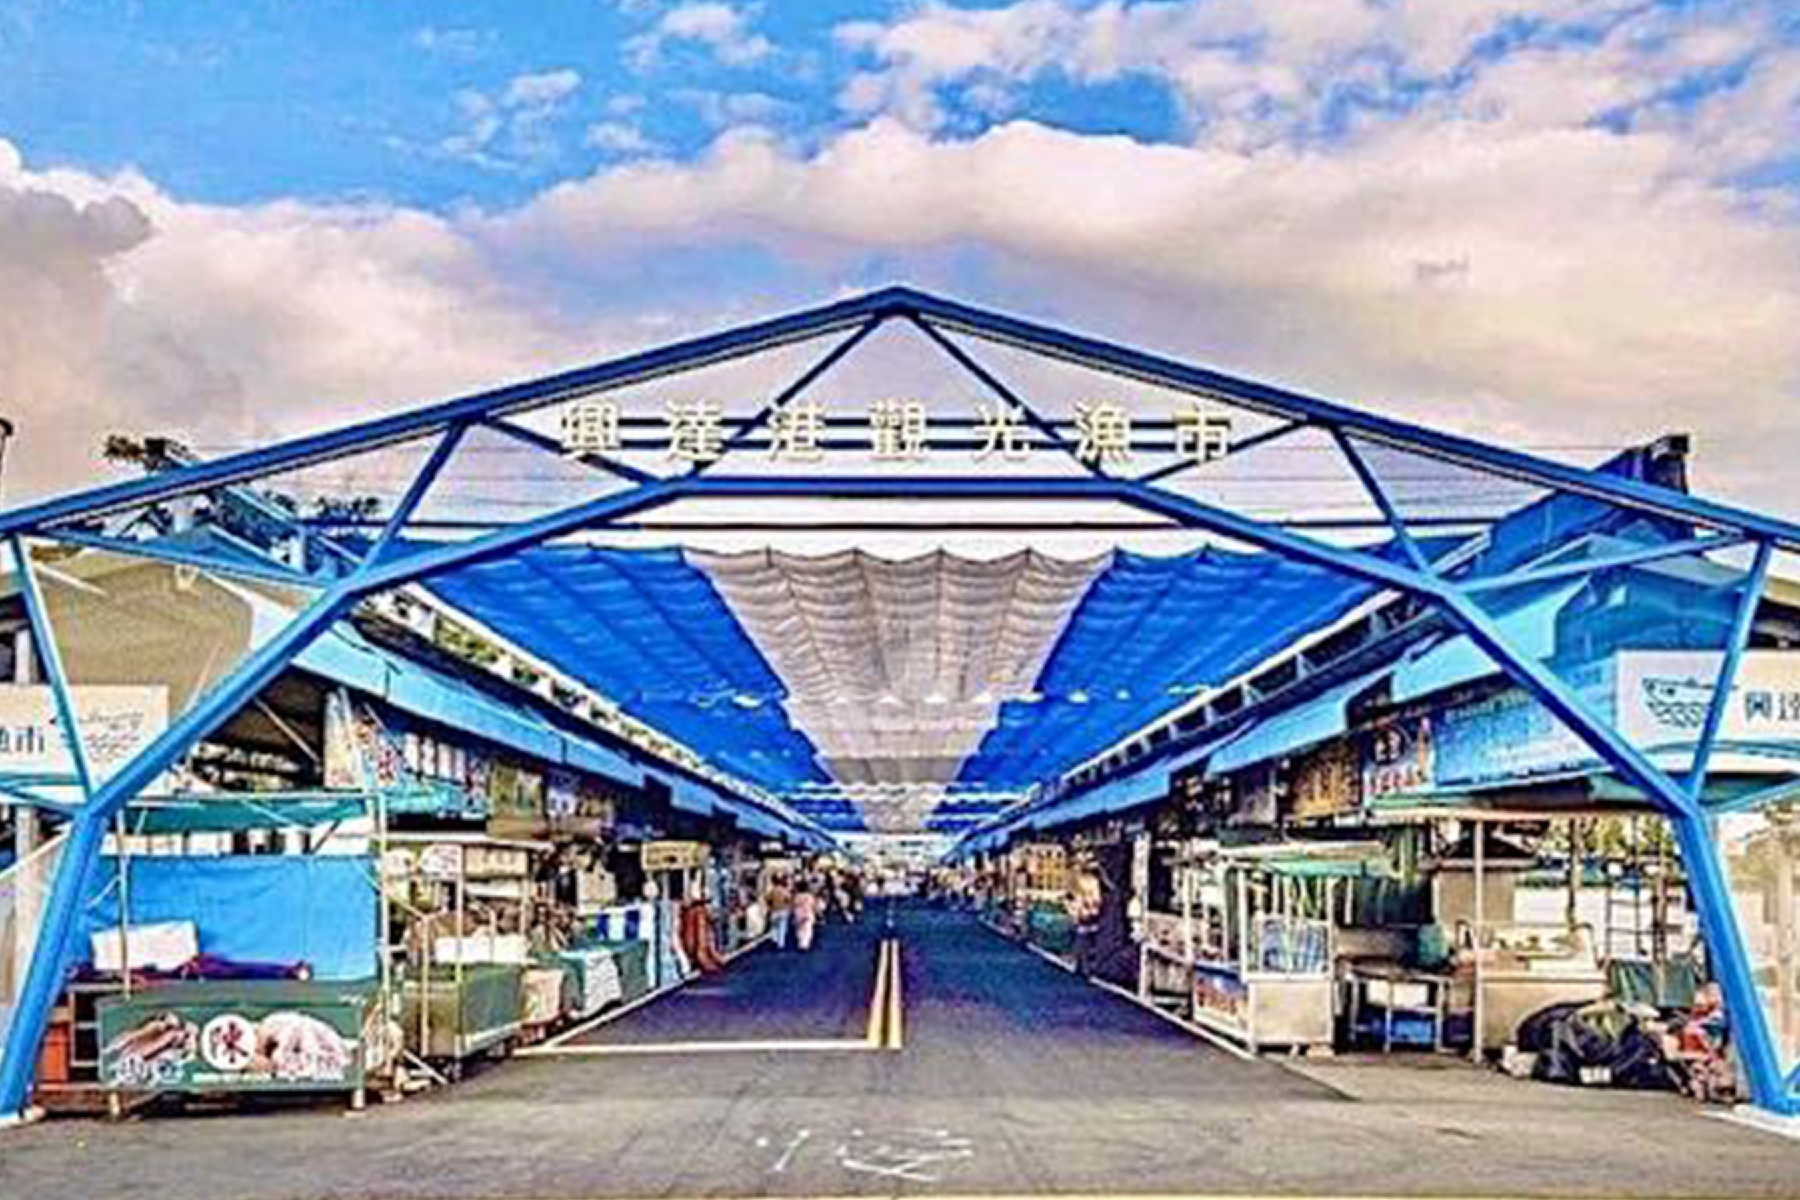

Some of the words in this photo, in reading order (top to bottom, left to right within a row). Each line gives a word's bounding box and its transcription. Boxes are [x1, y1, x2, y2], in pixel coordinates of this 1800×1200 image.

[560, 400, 1233, 461] 興達港觀光漁市
